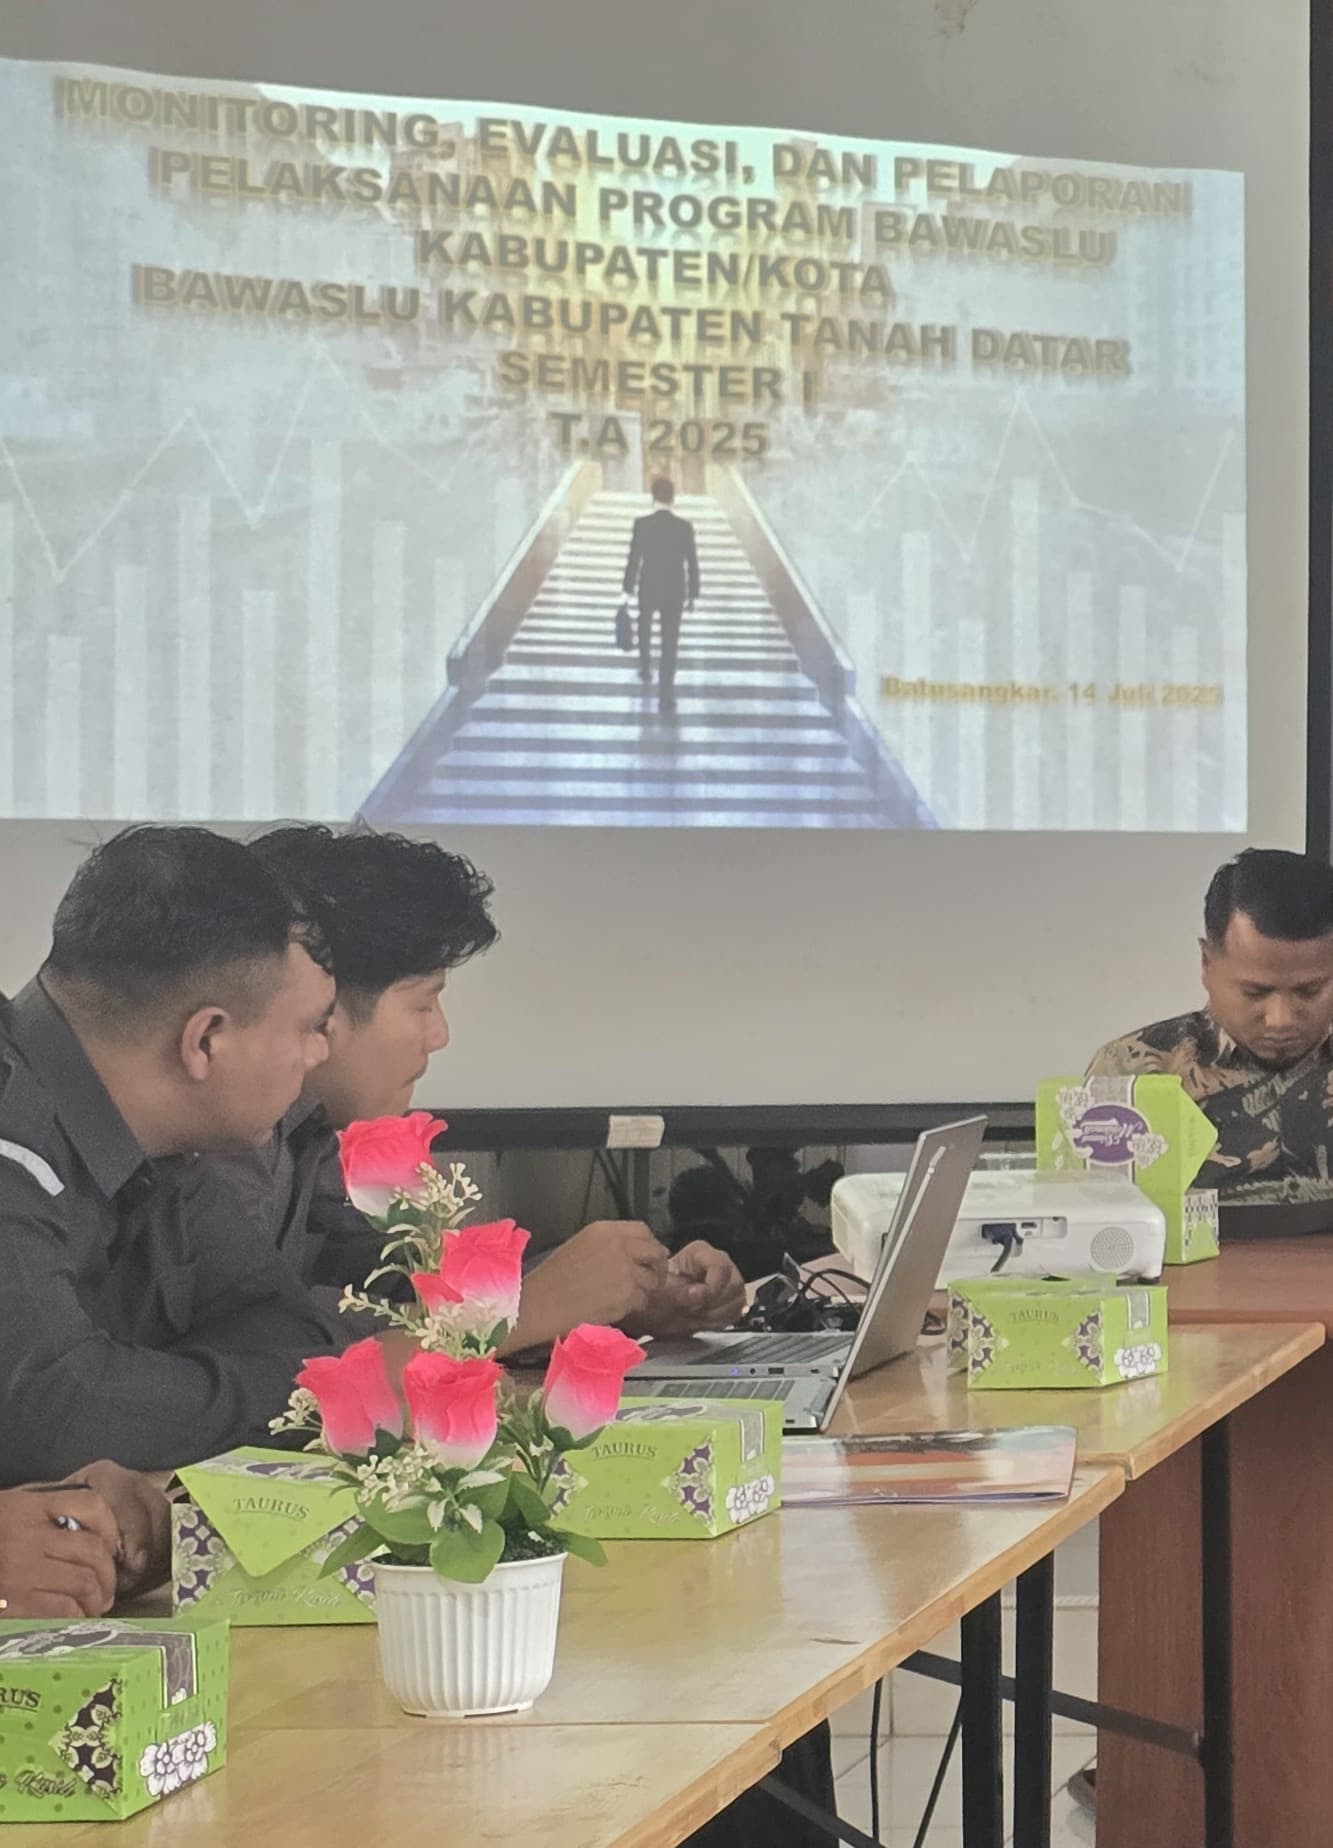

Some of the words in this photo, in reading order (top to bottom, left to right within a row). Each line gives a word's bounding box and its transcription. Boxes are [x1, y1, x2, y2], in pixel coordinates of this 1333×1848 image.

[53, 76, 456, 158] MONITORING,
[479, 117, 754, 184] EVALUASI,
[772, 142, 877, 190] DAN
[894, 156, 1193, 218] PELAPORAN
[148, 146, 577, 220] PELAKSANAAN
[599, 187, 856, 240] PROGRAM
[873, 210, 1118, 265] BAWASLU
[413, 230, 896, 300] KABUPATEN/KOTA
[132, 263, 422, 324] BAWASLU
[441, 289, 763, 346] KABUPATEN
[780, 311, 957, 364] TANAH
[971, 327, 1133, 376] DATAR
[499, 351, 784, 402] SEMESTER
[802, 371, 814, 402] I
[551, 411, 632, 456] T.A
[648, 416, 770, 458] 2025
[1069, 682, 1098, 705] 14
[1008, 1308, 1060, 1323] TAURUS
[591, 1441, 658, 1460] TAURUS
[232, 1496, 310, 1521] TAURUS
